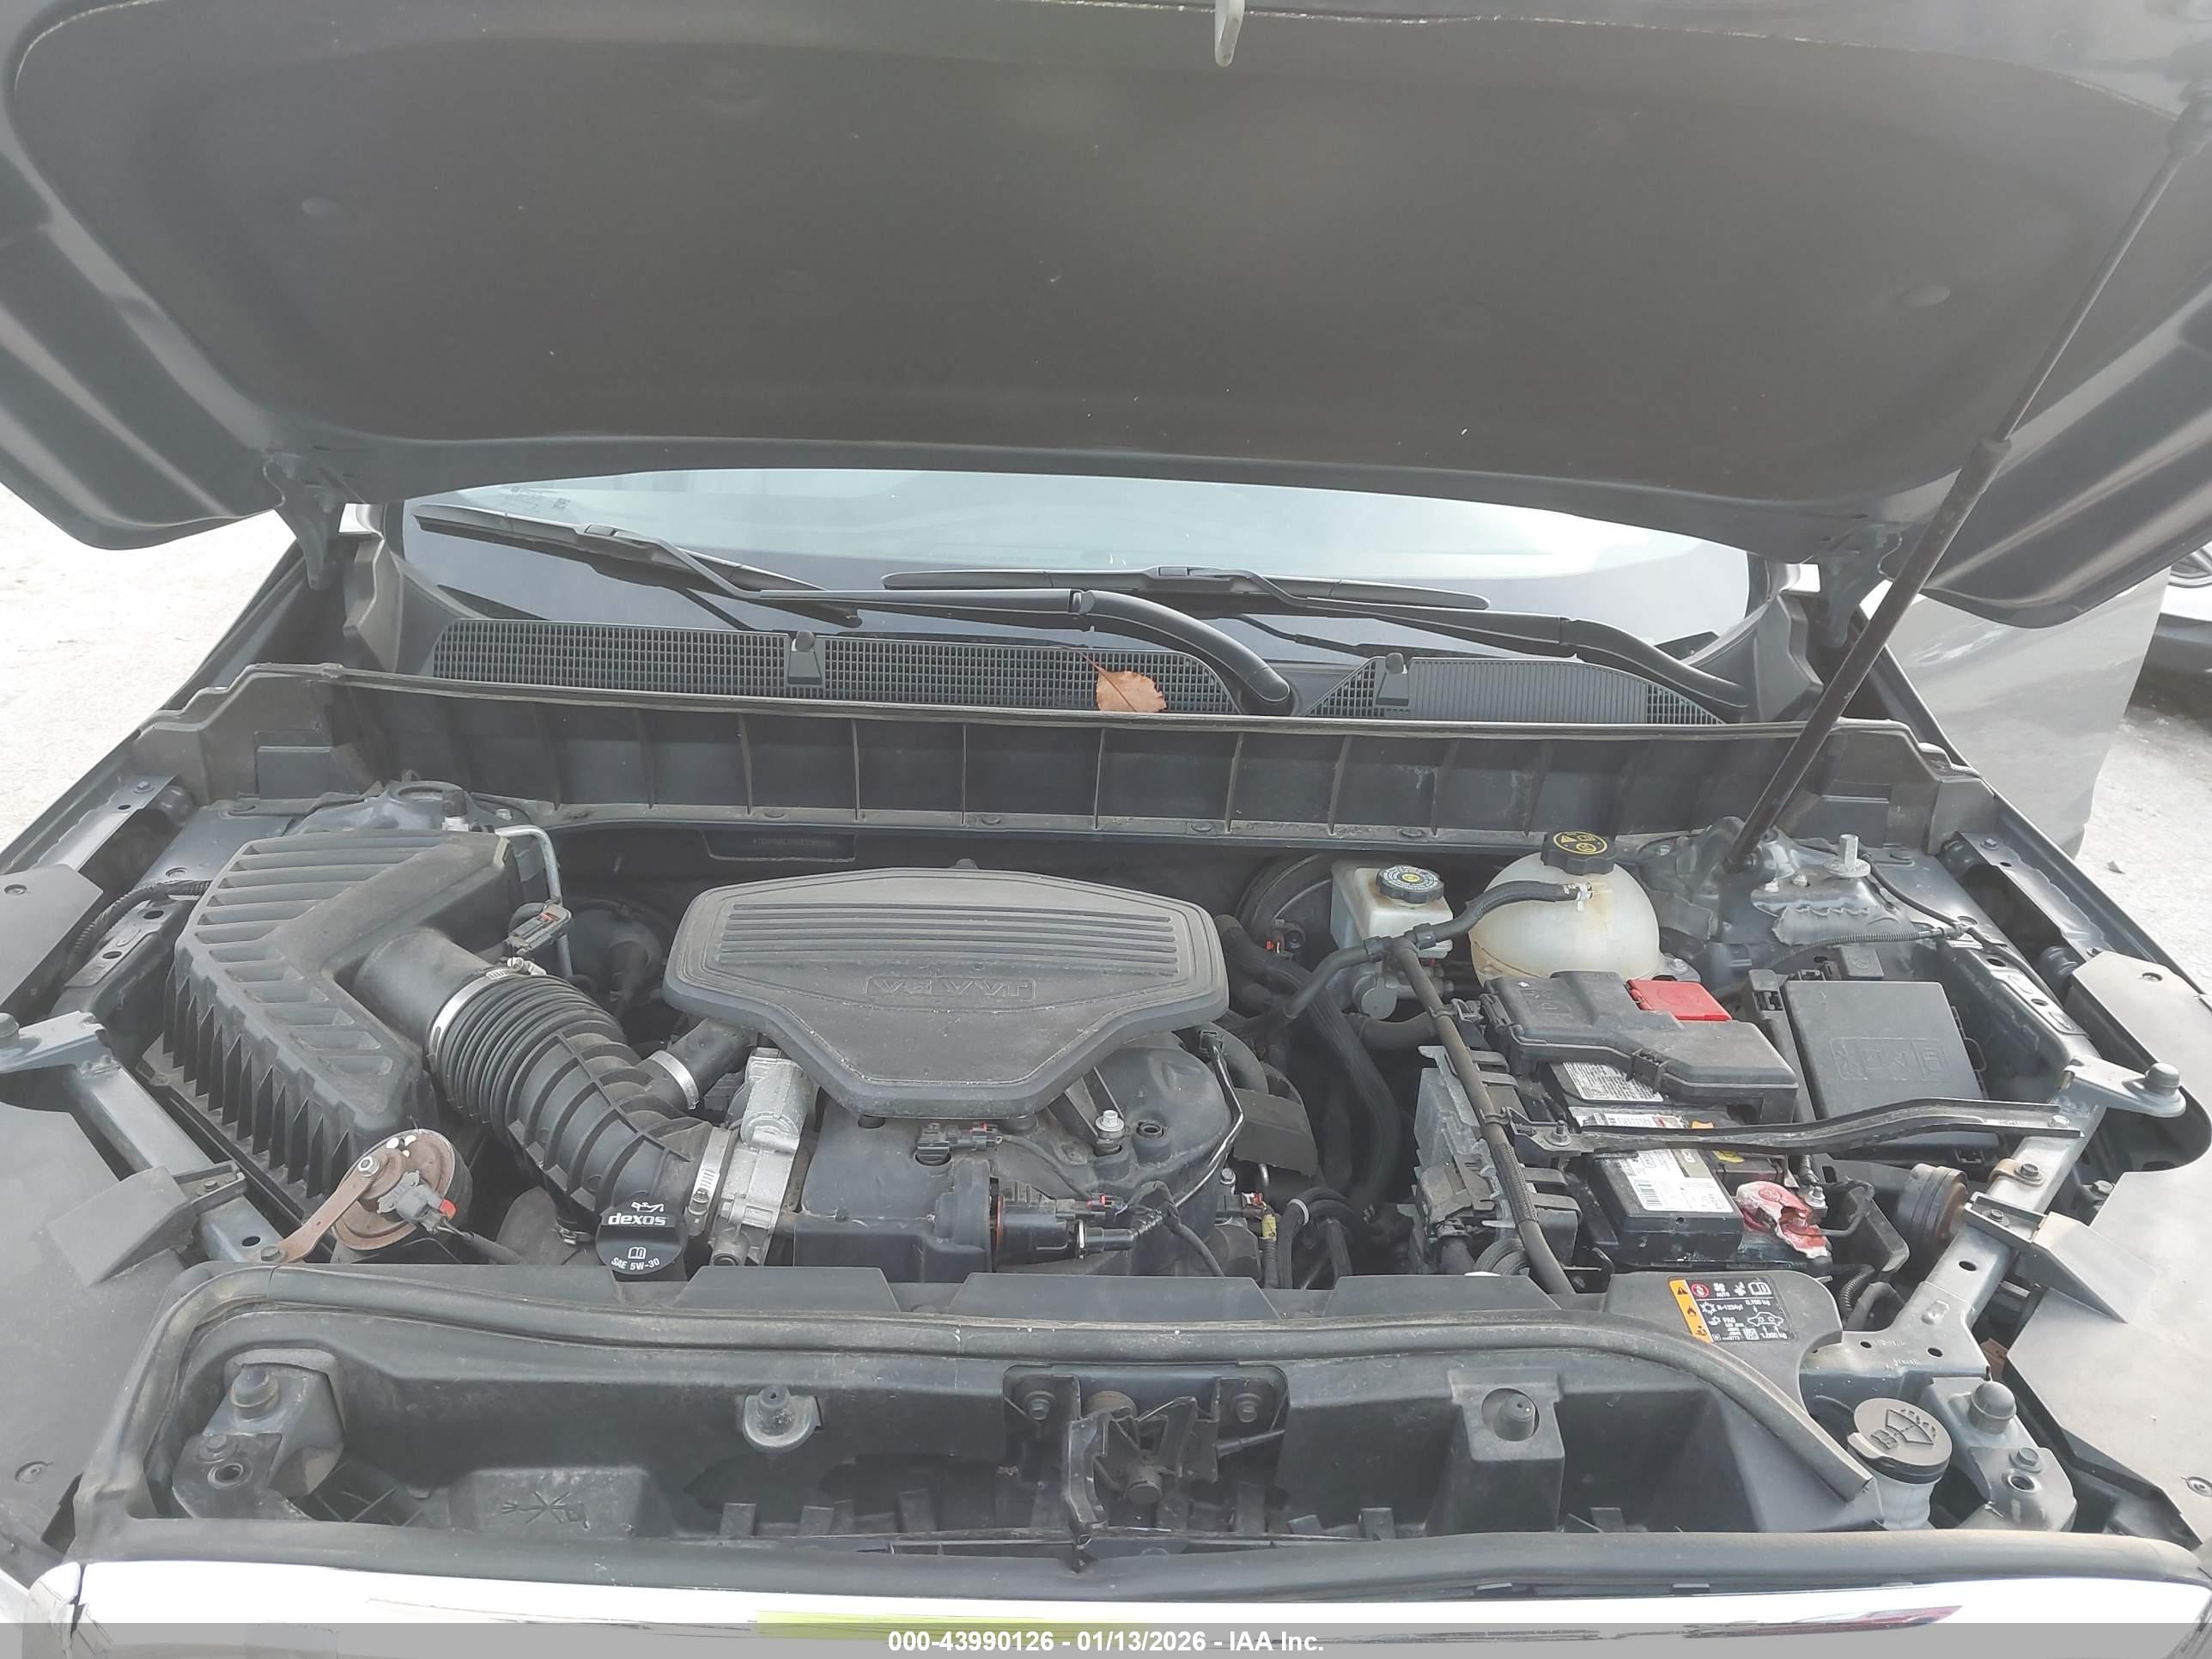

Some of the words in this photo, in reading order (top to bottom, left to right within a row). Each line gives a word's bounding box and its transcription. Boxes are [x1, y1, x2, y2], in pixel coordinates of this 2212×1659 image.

[607, 1212, 668, 1226] dexos
[611, 1257, 628, 1269] SAE
[629, 1257, 660, 1271] 5W-30
